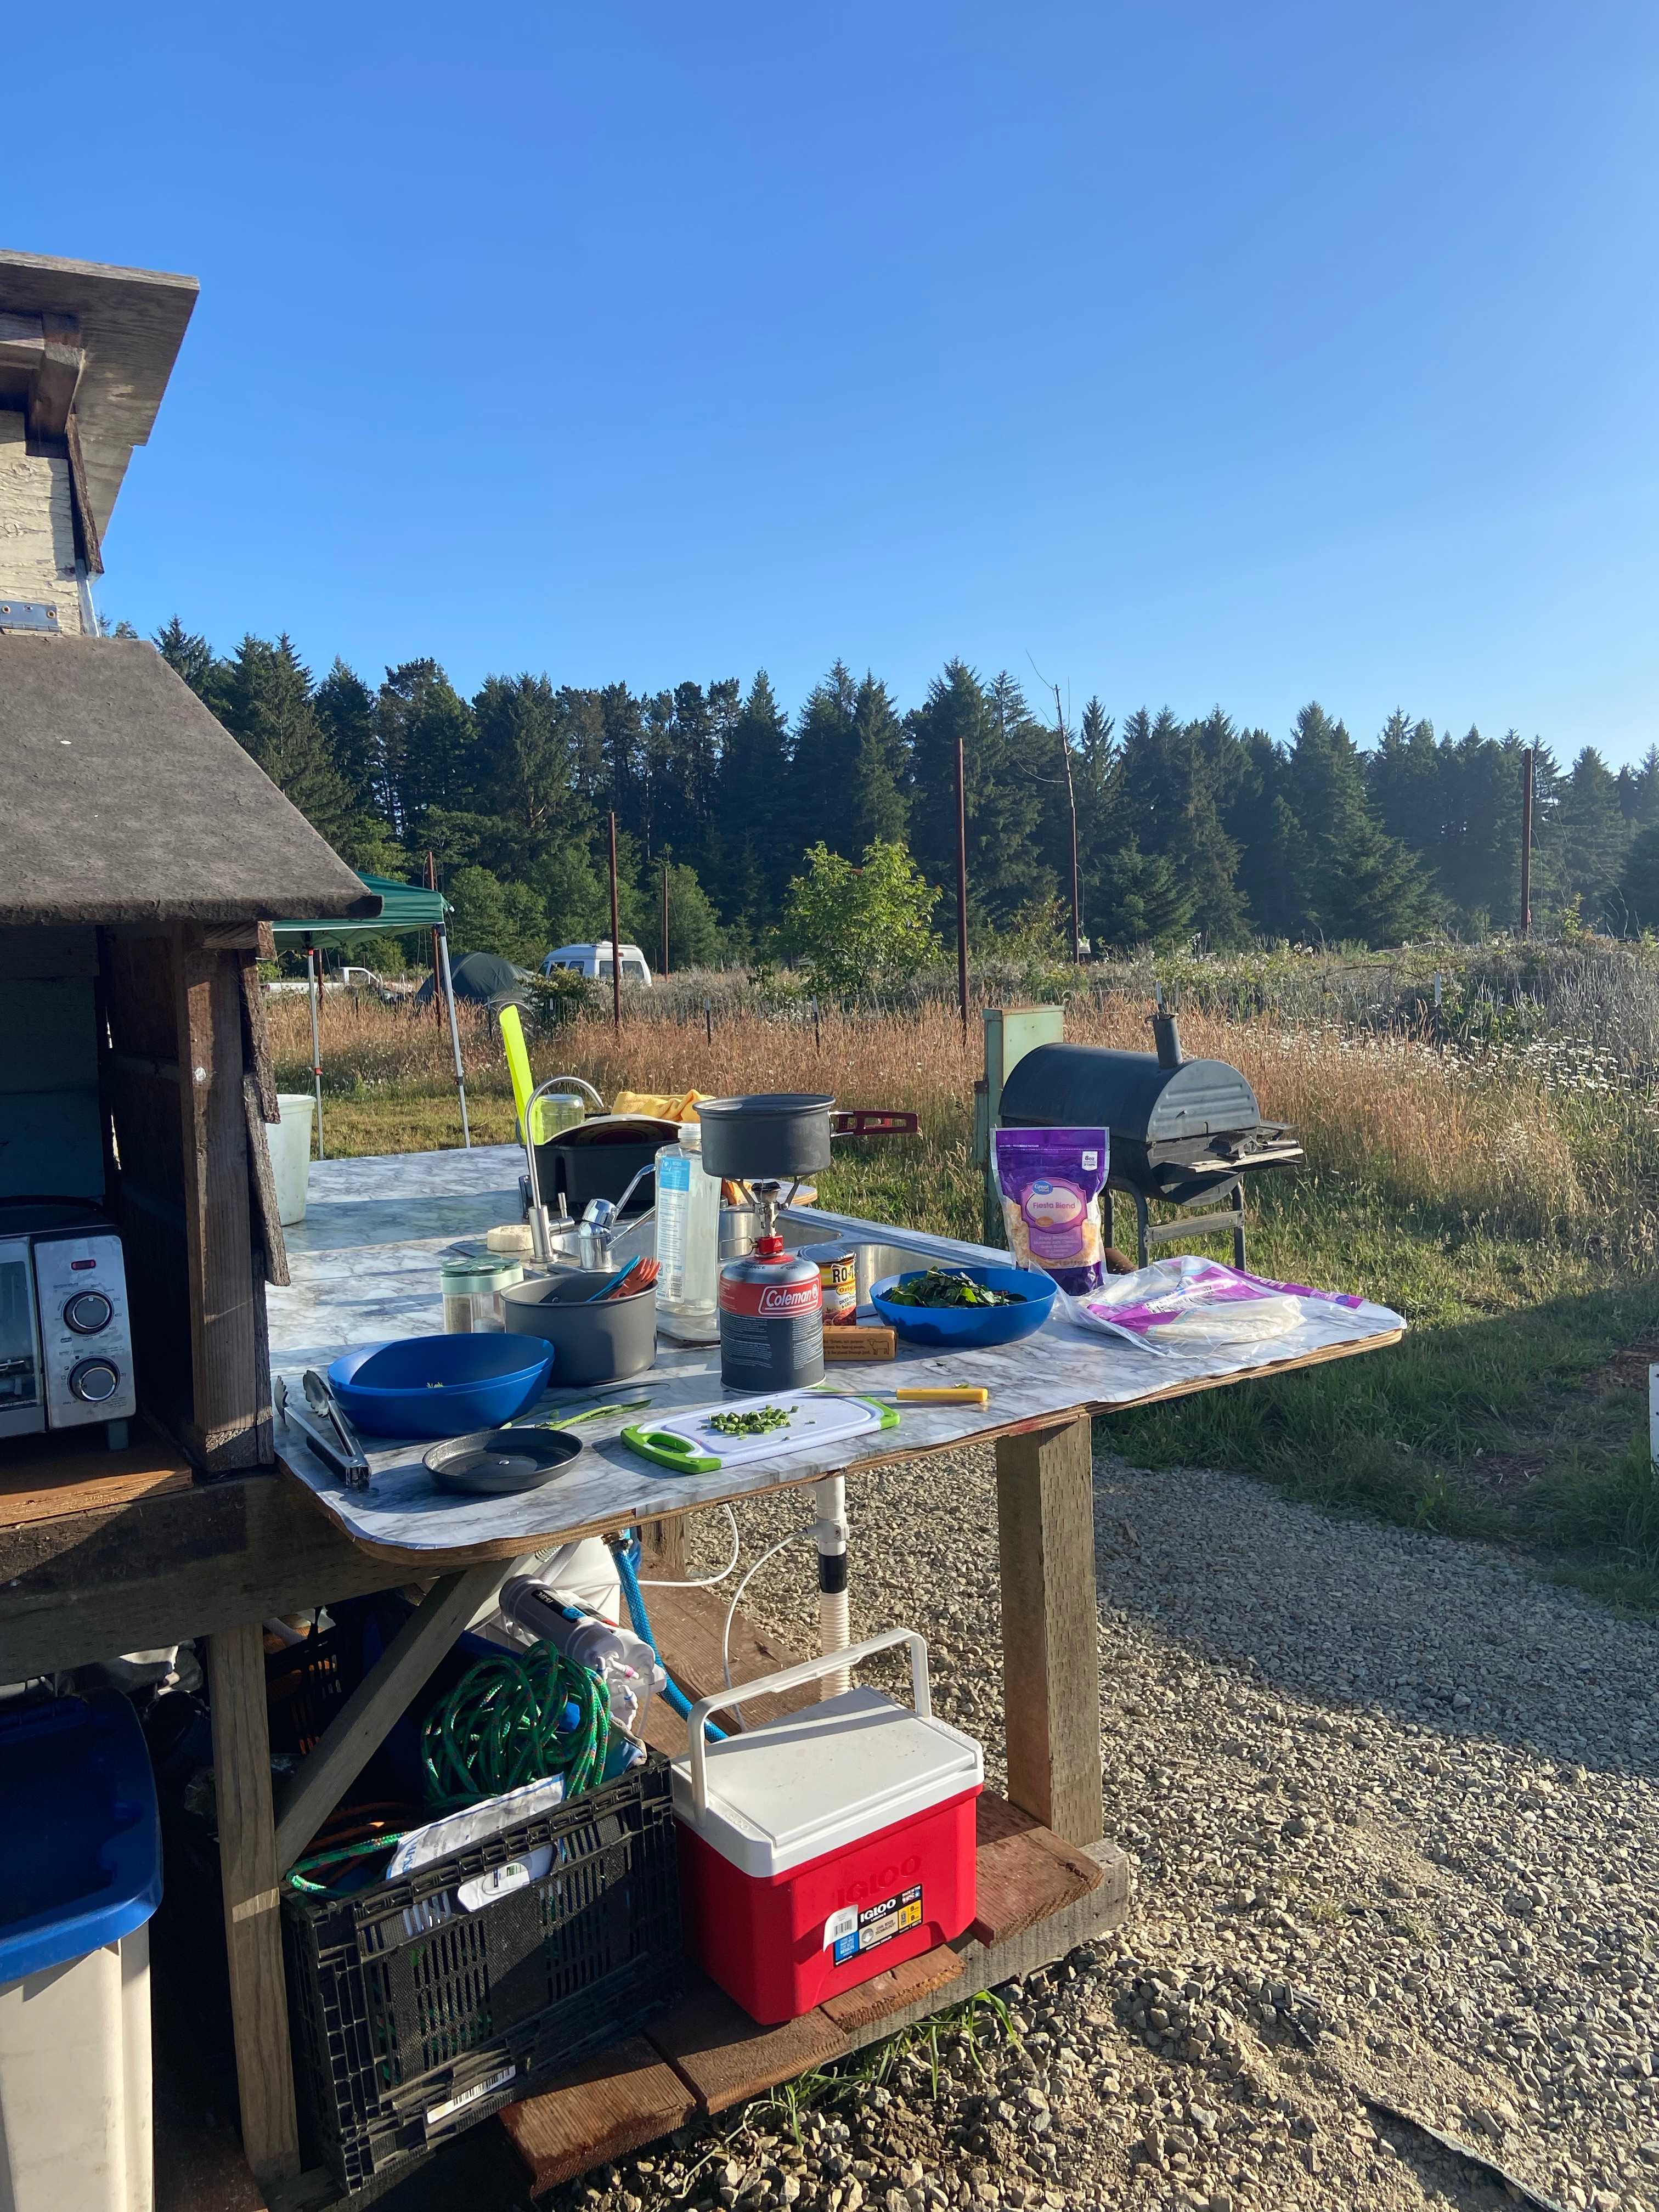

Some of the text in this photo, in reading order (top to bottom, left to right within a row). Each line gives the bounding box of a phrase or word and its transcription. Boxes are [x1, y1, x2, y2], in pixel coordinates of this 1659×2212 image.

[766, 1289, 812, 1307] Coleman
[837, 1855, 922, 1909] IGLOO
[860, 1898, 896, 1923] IGLOO
